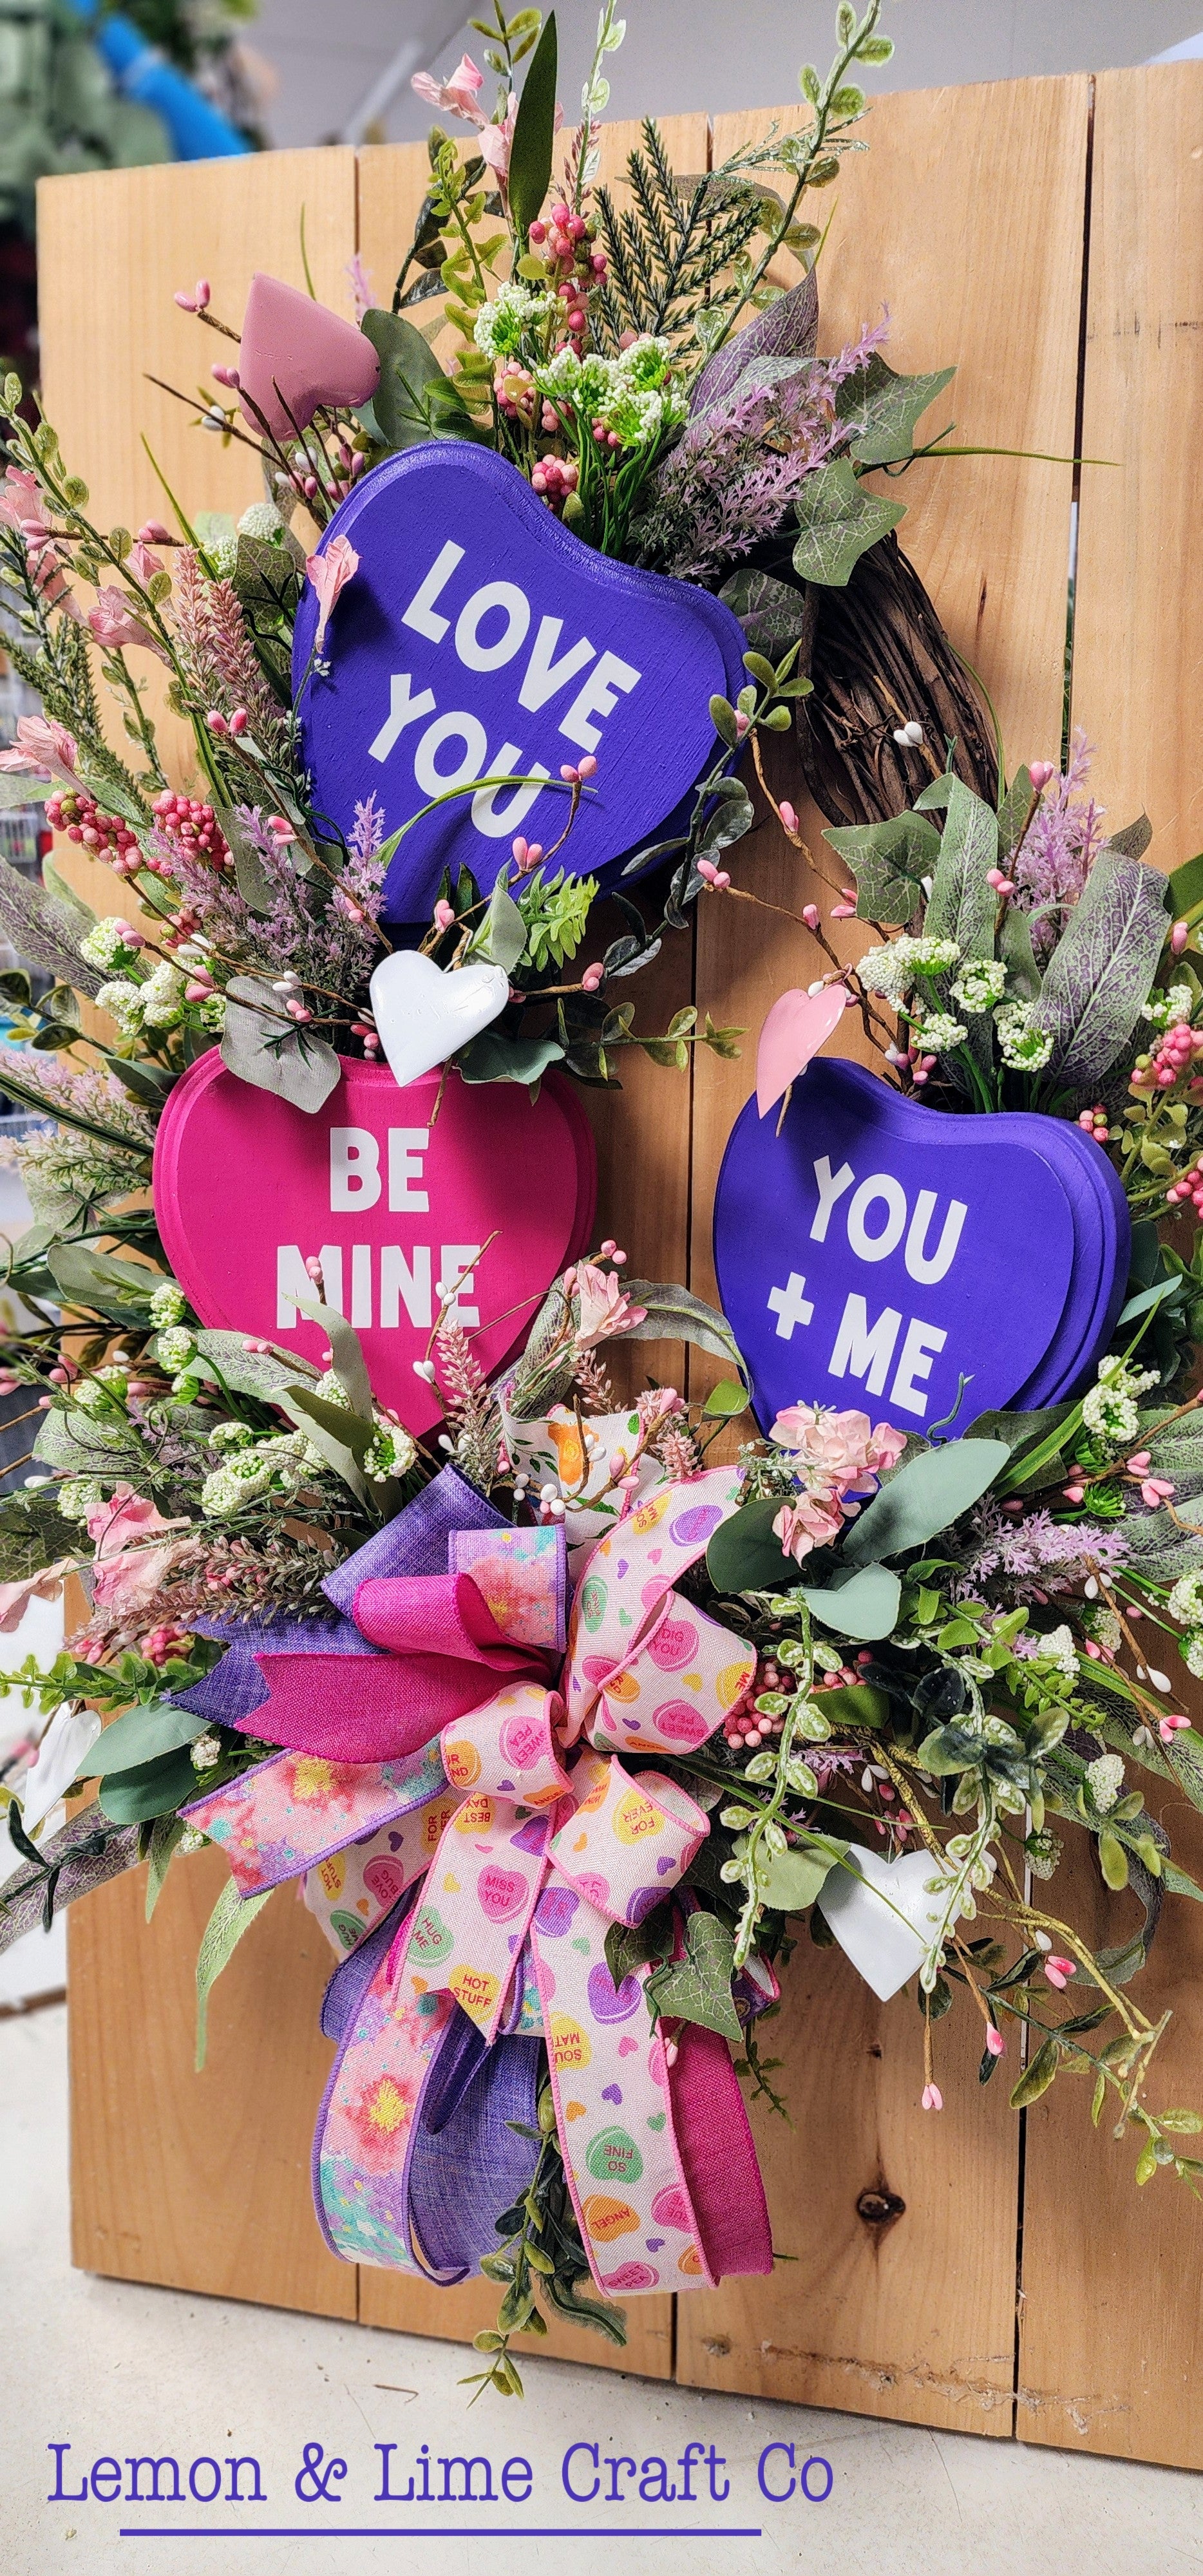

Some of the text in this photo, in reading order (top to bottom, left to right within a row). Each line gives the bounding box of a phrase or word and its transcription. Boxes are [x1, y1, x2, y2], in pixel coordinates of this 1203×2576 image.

[401, 539, 642, 753] LOVE
[368, 674, 551, 837] YOU
[330, 1127, 430, 1212] BE
[810, 1155, 967, 1285] YOU
[276, 1245, 480, 1329] MINE
[767, 1271, 948, 1417] + ME
[662, 1628, 684, 1642] DIG
[653, 1641, 679, 1656] YOU
[735, 1671, 750, 1690] ME
[668, 1712, 695, 1725] PEA
[509, 1725, 533, 1747] PEA
[659, 1721, 706, 1738] SWEET
[515, 1730, 546, 1766] SWEET
[466, 1798, 488, 1808] DAY
[623, 1801, 653, 1823] EVER
[464, 1812, 491, 1823] BEST
[630, 1817, 655, 1835] FOR
[428, 1815, 437, 1842] FOR
[321, 1869, 332, 1891] HOT
[381, 1870, 399, 1894] BUG
[486, 1876, 515, 1892] MISS
[485, 1890, 510, 1906] YOU
[339, 1924, 353, 1946] HUG
[413, 1931, 430, 1951] ME
[422, 1917, 442, 1945] HUG
[462, 1974, 489, 1991] HOT
[454, 1987, 492, 2008] STUFF
[603, 2145, 633, 2159] FINE
[607, 2161, 626, 2172] SO
[591, 2208, 630, 2230] ANGEL
[608, 2265, 644, 2287] SWEET
[625, 2276, 649, 2287] PEA
